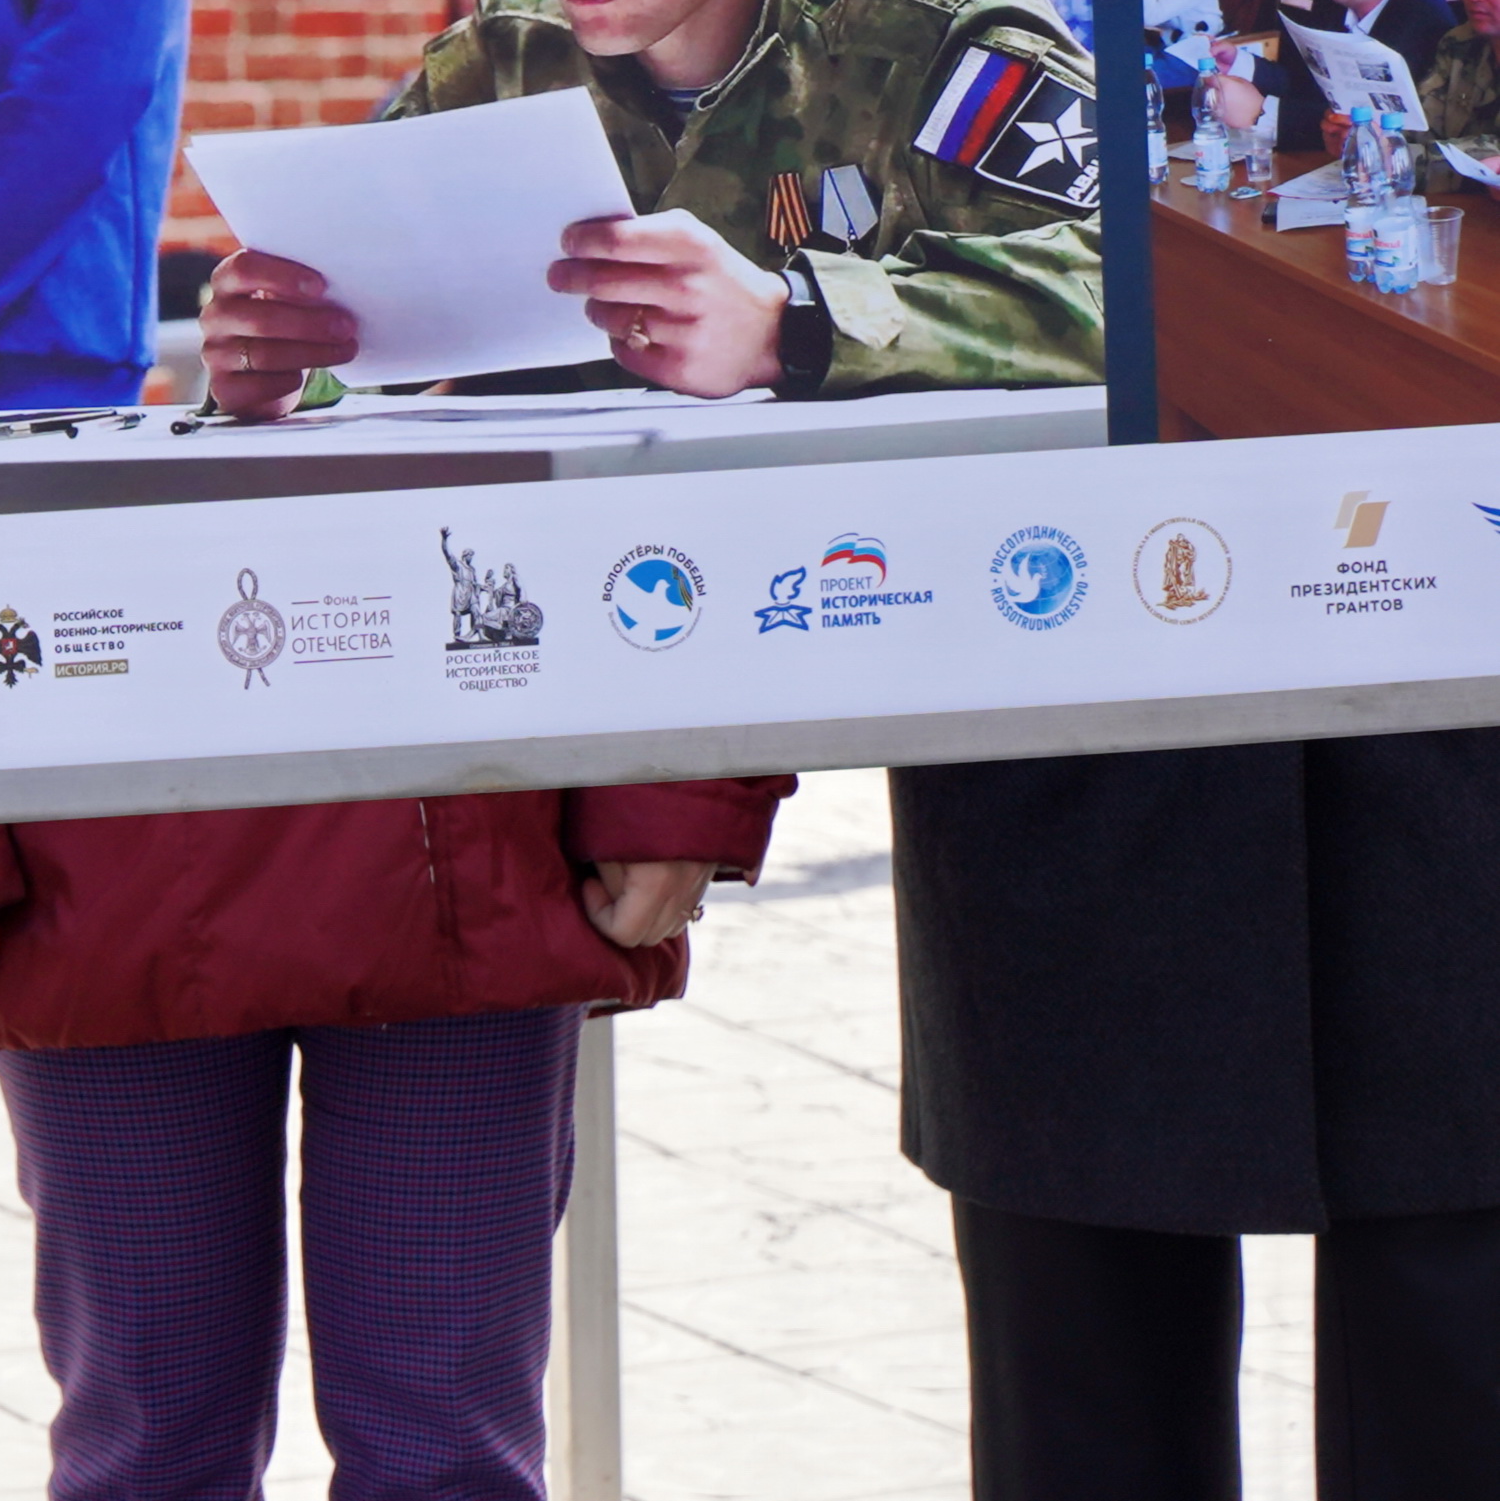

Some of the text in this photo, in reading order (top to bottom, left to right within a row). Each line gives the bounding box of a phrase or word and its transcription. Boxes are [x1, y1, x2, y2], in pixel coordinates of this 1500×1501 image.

[990, 525, 1088, 574] РОССОТРУДНИЧЕСТВО
[602, 544, 707, 602] ВОЛОНТЁРЫ ПОБЕДЫ
[1336, 560, 1388, 575] ФОНД
[820, 576, 873, 593] ПРОЕКТ
[1290, 576, 1438, 598] ПРЕЗИДЕНТСКИХ
[821, 590, 933, 610] ИСТОРИЧЕСКАЯ
[991, 580, 1089, 632] ROSSOTRUDNICHESTVO
[1326, 598, 1403, 615] ГРАНТОВ
[53, 608, 124, 622] РОССИЙСКОЕ
[291, 609, 391, 631] ИСТОРИЯ
[822, 611, 882, 628] ПАМЯТЬ
[53, 620, 184, 638] ВОЕННО-ИСТОРИЧЕСКОЕ
[54, 640, 125, 654] ОБЩЕСТВО
[291, 633, 392, 655] ОТЕЧЕСТВА
[446, 649, 540, 666] РОССИЙСКОЕ
[56, 661, 127, 677] ИСТОРИЯ.РФ
[446, 662, 541, 679] ИСТОРИЧЕСКОЕ
[459, 677, 528, 692] ОБЩЕСТВО
